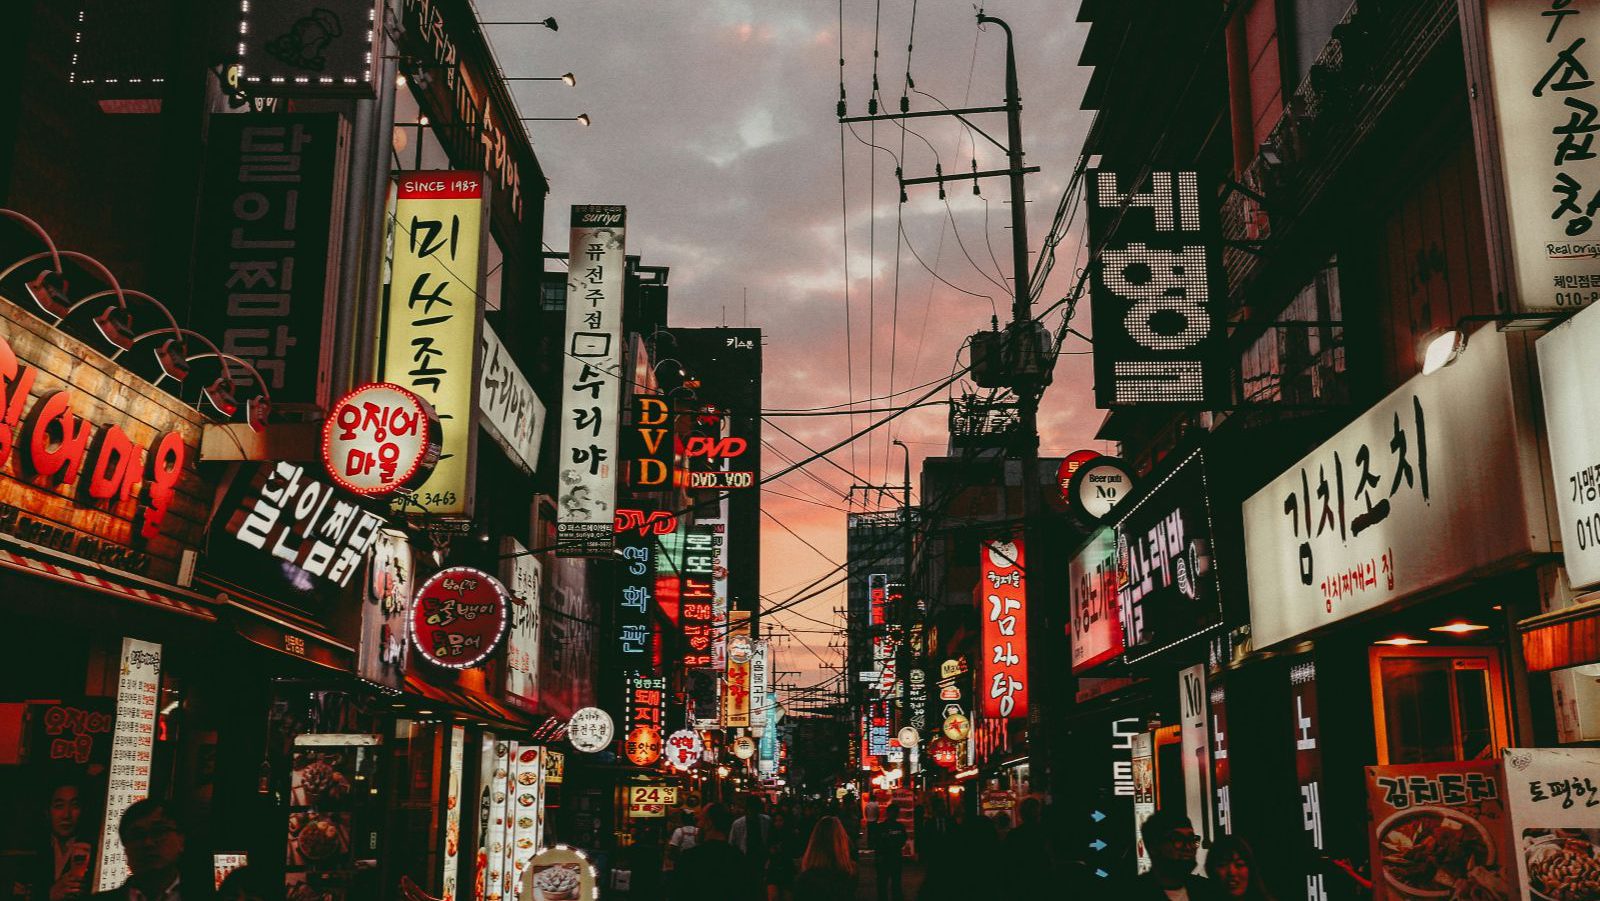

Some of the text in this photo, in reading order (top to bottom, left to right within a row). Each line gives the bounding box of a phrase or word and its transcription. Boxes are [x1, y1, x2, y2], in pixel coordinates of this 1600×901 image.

[404, 181, 479, 192] SINCE 1987
[582, 212, 622, 226] suriya
[1546, 244, 1571, 255] Real
[584, 242, 606, 330] 퓨전주점
[337, 401, 419, 443] 오징어
[572, 364, 609, 475] 수리야
[345, 442, 400, 484] 마을
[637, 398, 669, 486] DVD
[685, 436, 748, 458] DVD
[88, 424, 185, 539] 마을
[425, 491, 457, 506] 3463
[1089, 474, 1107, 483] Beer
[1096, 485, 1116, 498] No
[1284, 394, 1430, 587] 김치조치
[614, 509, 678, 537] DVD
[1321, 547, 1394, 614] 김치찌개의 집
[987, 594, 1023, 717] 감자탕
[1183, 673, 1202, 718] No
[635, 788, 660, 802] 24
